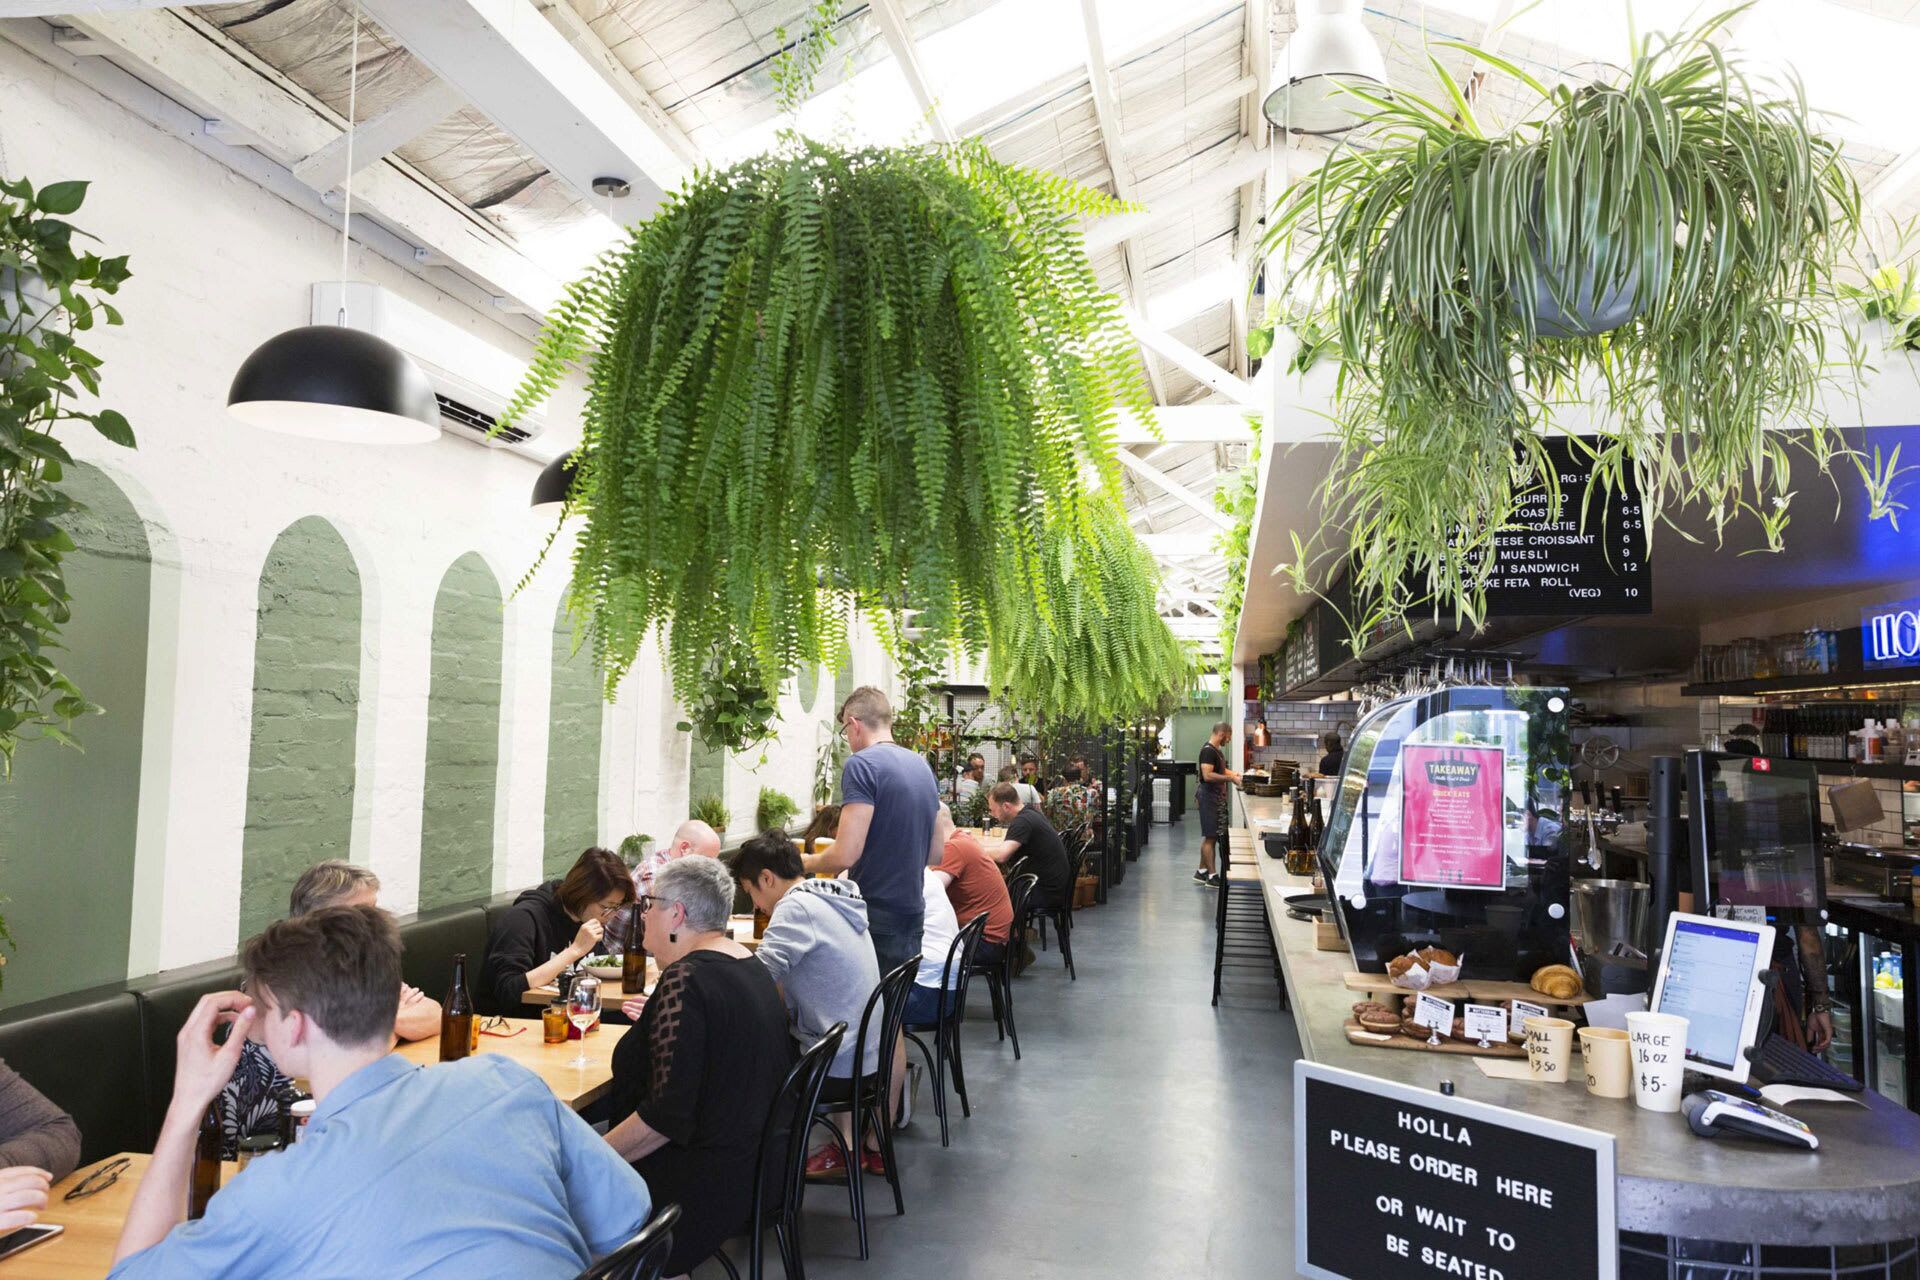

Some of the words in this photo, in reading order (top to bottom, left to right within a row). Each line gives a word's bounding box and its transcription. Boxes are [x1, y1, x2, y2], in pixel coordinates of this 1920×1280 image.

[1515, 494, 1569, 504] BURRO
[1514, 508, 1564, 518] TOASE
[1528, 521, 1576, 531] TOASTIE
[1479, 536, 1524, 547] CEESE
[1529, 534, 1595, 546] CROISSANT
[1623, 534, 1630, 544] 6
[1500, 549, 1548, 560] MUESLI
[1623, 548, 1630, 558] 9
[1440, 563, 1504, 575] PSTRMI
[1510, 562, 1580, 574] SANDWICH
[1624, 562, 1637, 573] 12
[1504, 577, 1530, 588] FETA
[1541, 576, 1572, 587] ROLL
[1569, 587, 1602, 599] (VEG)
[1625, 587, 1638, 597] 10
[1429, 764, 1477, 776] TAKEAWAY
[1631, 1032, 1671, 1046] LARGE
[1398, 1111, 1472, 1146] HOLLA
[1330, 1129, 1401, 1164] PLEASE
[1409, 1153, 1479, 1187] ORDER
[1496, 1176, 1553, 1209] HERE
[1376, 1196, 1404, 1217] OR
[1415, 1205, 1467, 1236] WAIT
[1486, 1227, 1516, 1252] TO
[1386, 1234, 1409, 1257] BE
